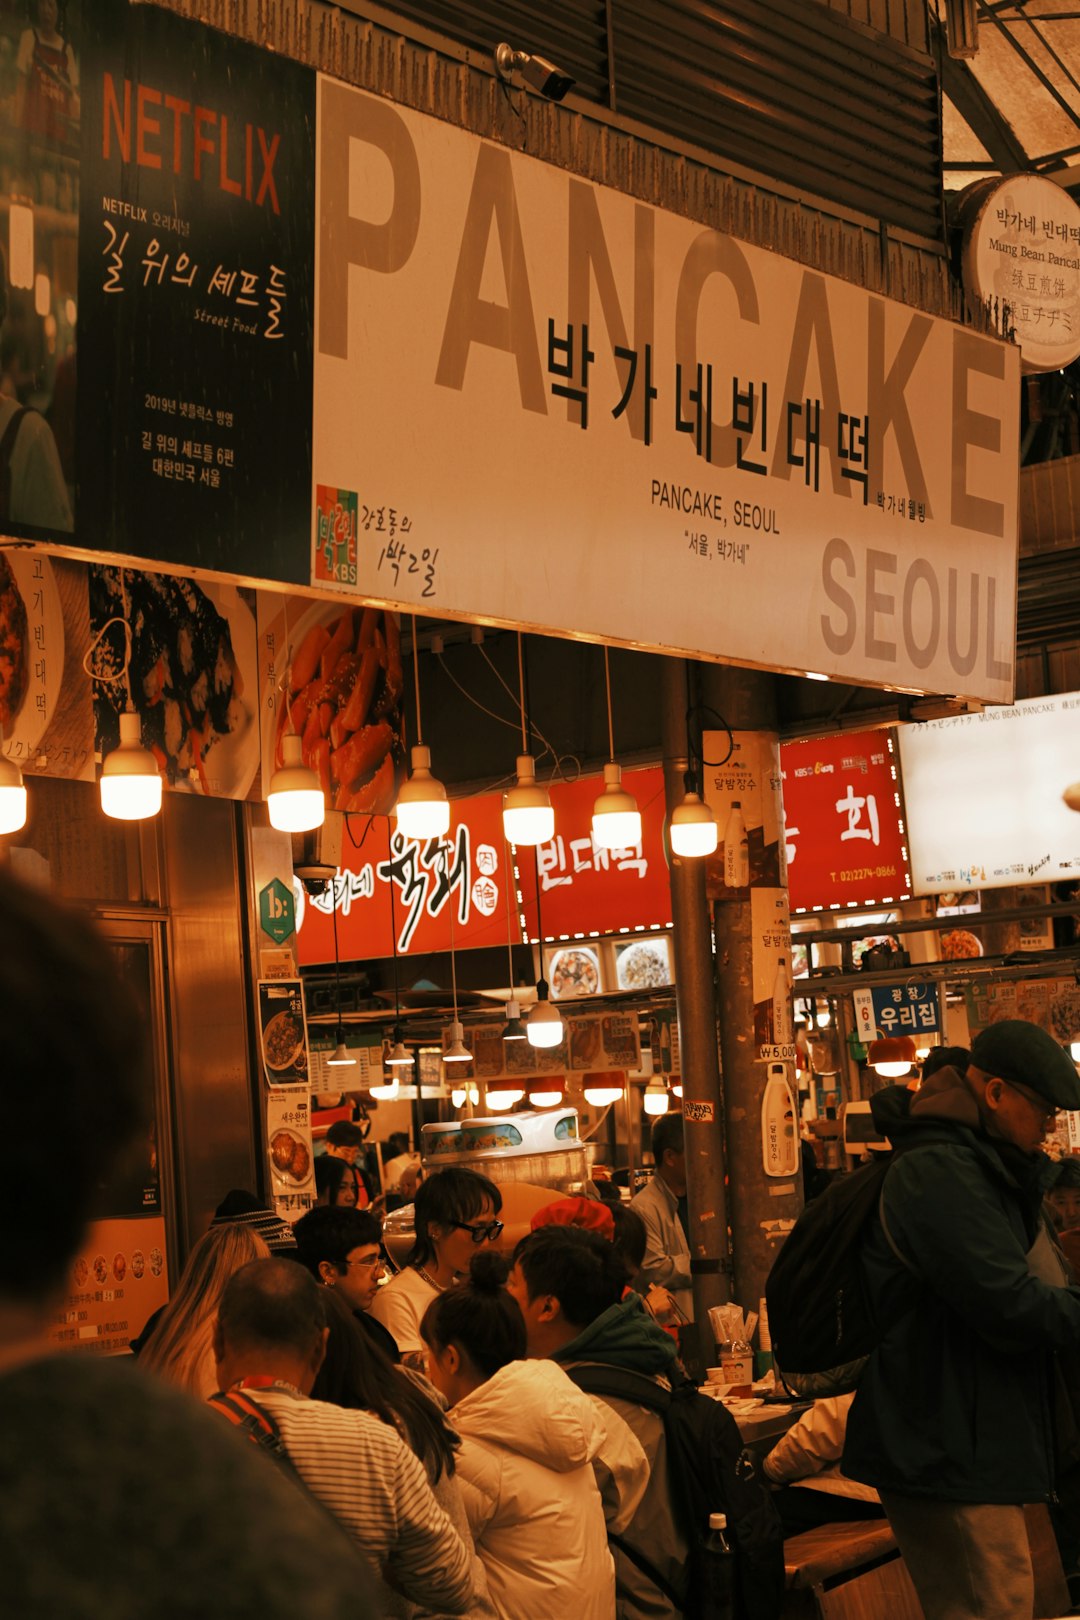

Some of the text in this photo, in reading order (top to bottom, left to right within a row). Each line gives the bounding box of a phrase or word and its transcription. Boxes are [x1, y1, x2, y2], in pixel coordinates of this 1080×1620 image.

[102, 71, 281, 215] NETFLIX
[102, 196, 190, 238] NETFLIX 오리지널
[996, 208, 1036, 236] 박가네
[989, 238, 1018, 258] Mung
[1021, 246, 1045, 263] Bean
[102, 220, 287, 338] 길 위의 셰프들
[194, 308, 258, 336] Street Food
[319, 78, 1005, 538] PANCAKE
[145, 393, 234, 428] 2019년 넷플릭스 방영
[142, 431, 152, 450] 길
[156, 434, 178, 456] 위의
[216, 447, 234, 467] 6편
[152, 458, 221, 488] 대한민국 서울
[361, 505, 412, 536] 강호동의
[651, 479, 780, 535] PANCAKE, SEOUL
[332, 563, 356, 583] KBS
[377, 539, 439, 597] 1박2일
[820, 537, 1012, 683] SEOUL
[978, 711, 1000, 723] MUNG
[1001, 708, 1021, 719] BEAN
[1022, 703, 1056, 716] PANCAKE
[714, 778, 757, 791] 달밤장수
[840, 866, 896, 882] 02)2274-0866
[891, 986, 919, 1003] 광장
[861, 1006, 870, 1021] 6
[863, 1022, 872, 1032] 호
[880, 1002, 936, 1031] 우리집
